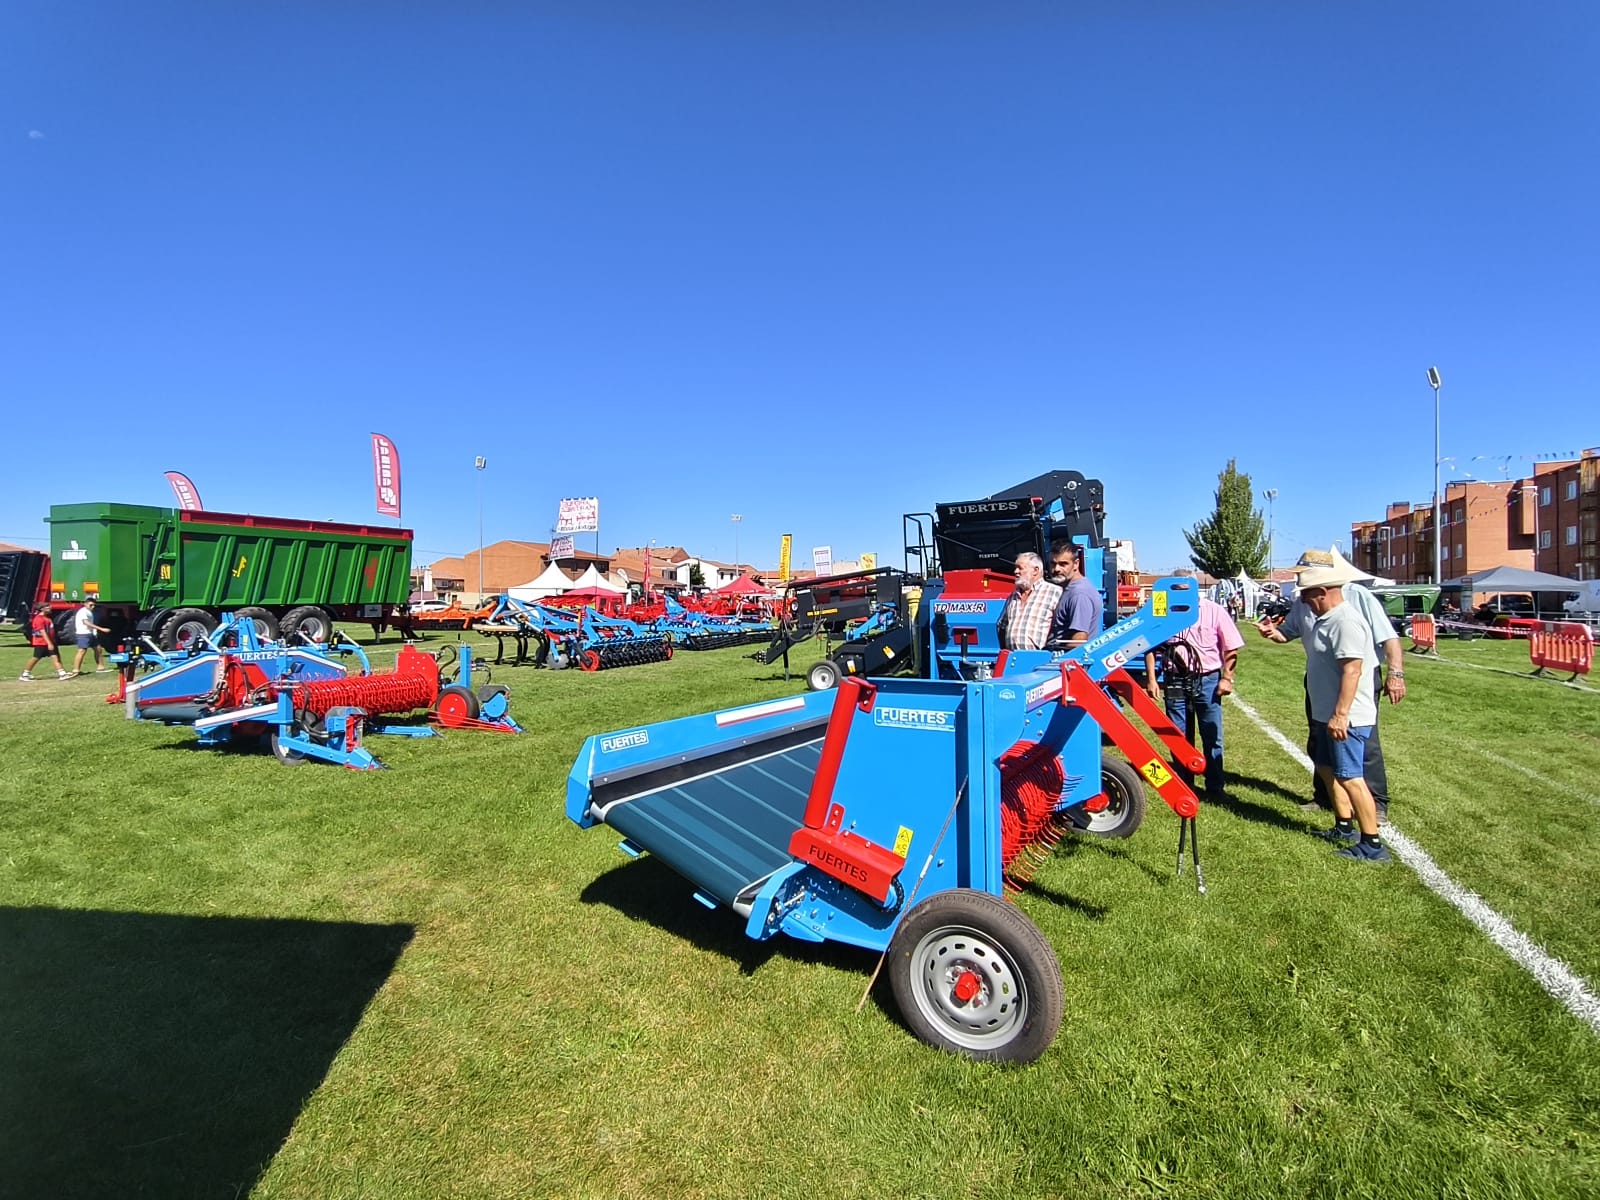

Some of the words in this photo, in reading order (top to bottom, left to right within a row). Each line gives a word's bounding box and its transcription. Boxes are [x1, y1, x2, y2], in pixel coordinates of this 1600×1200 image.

[948, 501, 1019, 515] FUERTES
[1084, 617, 1140, 653] FUERTES
[881, 708, 946, 725] FUERTES
[602, 732, 647, 751] FUERTES
[809, 844, 868, 882] FUERTES
